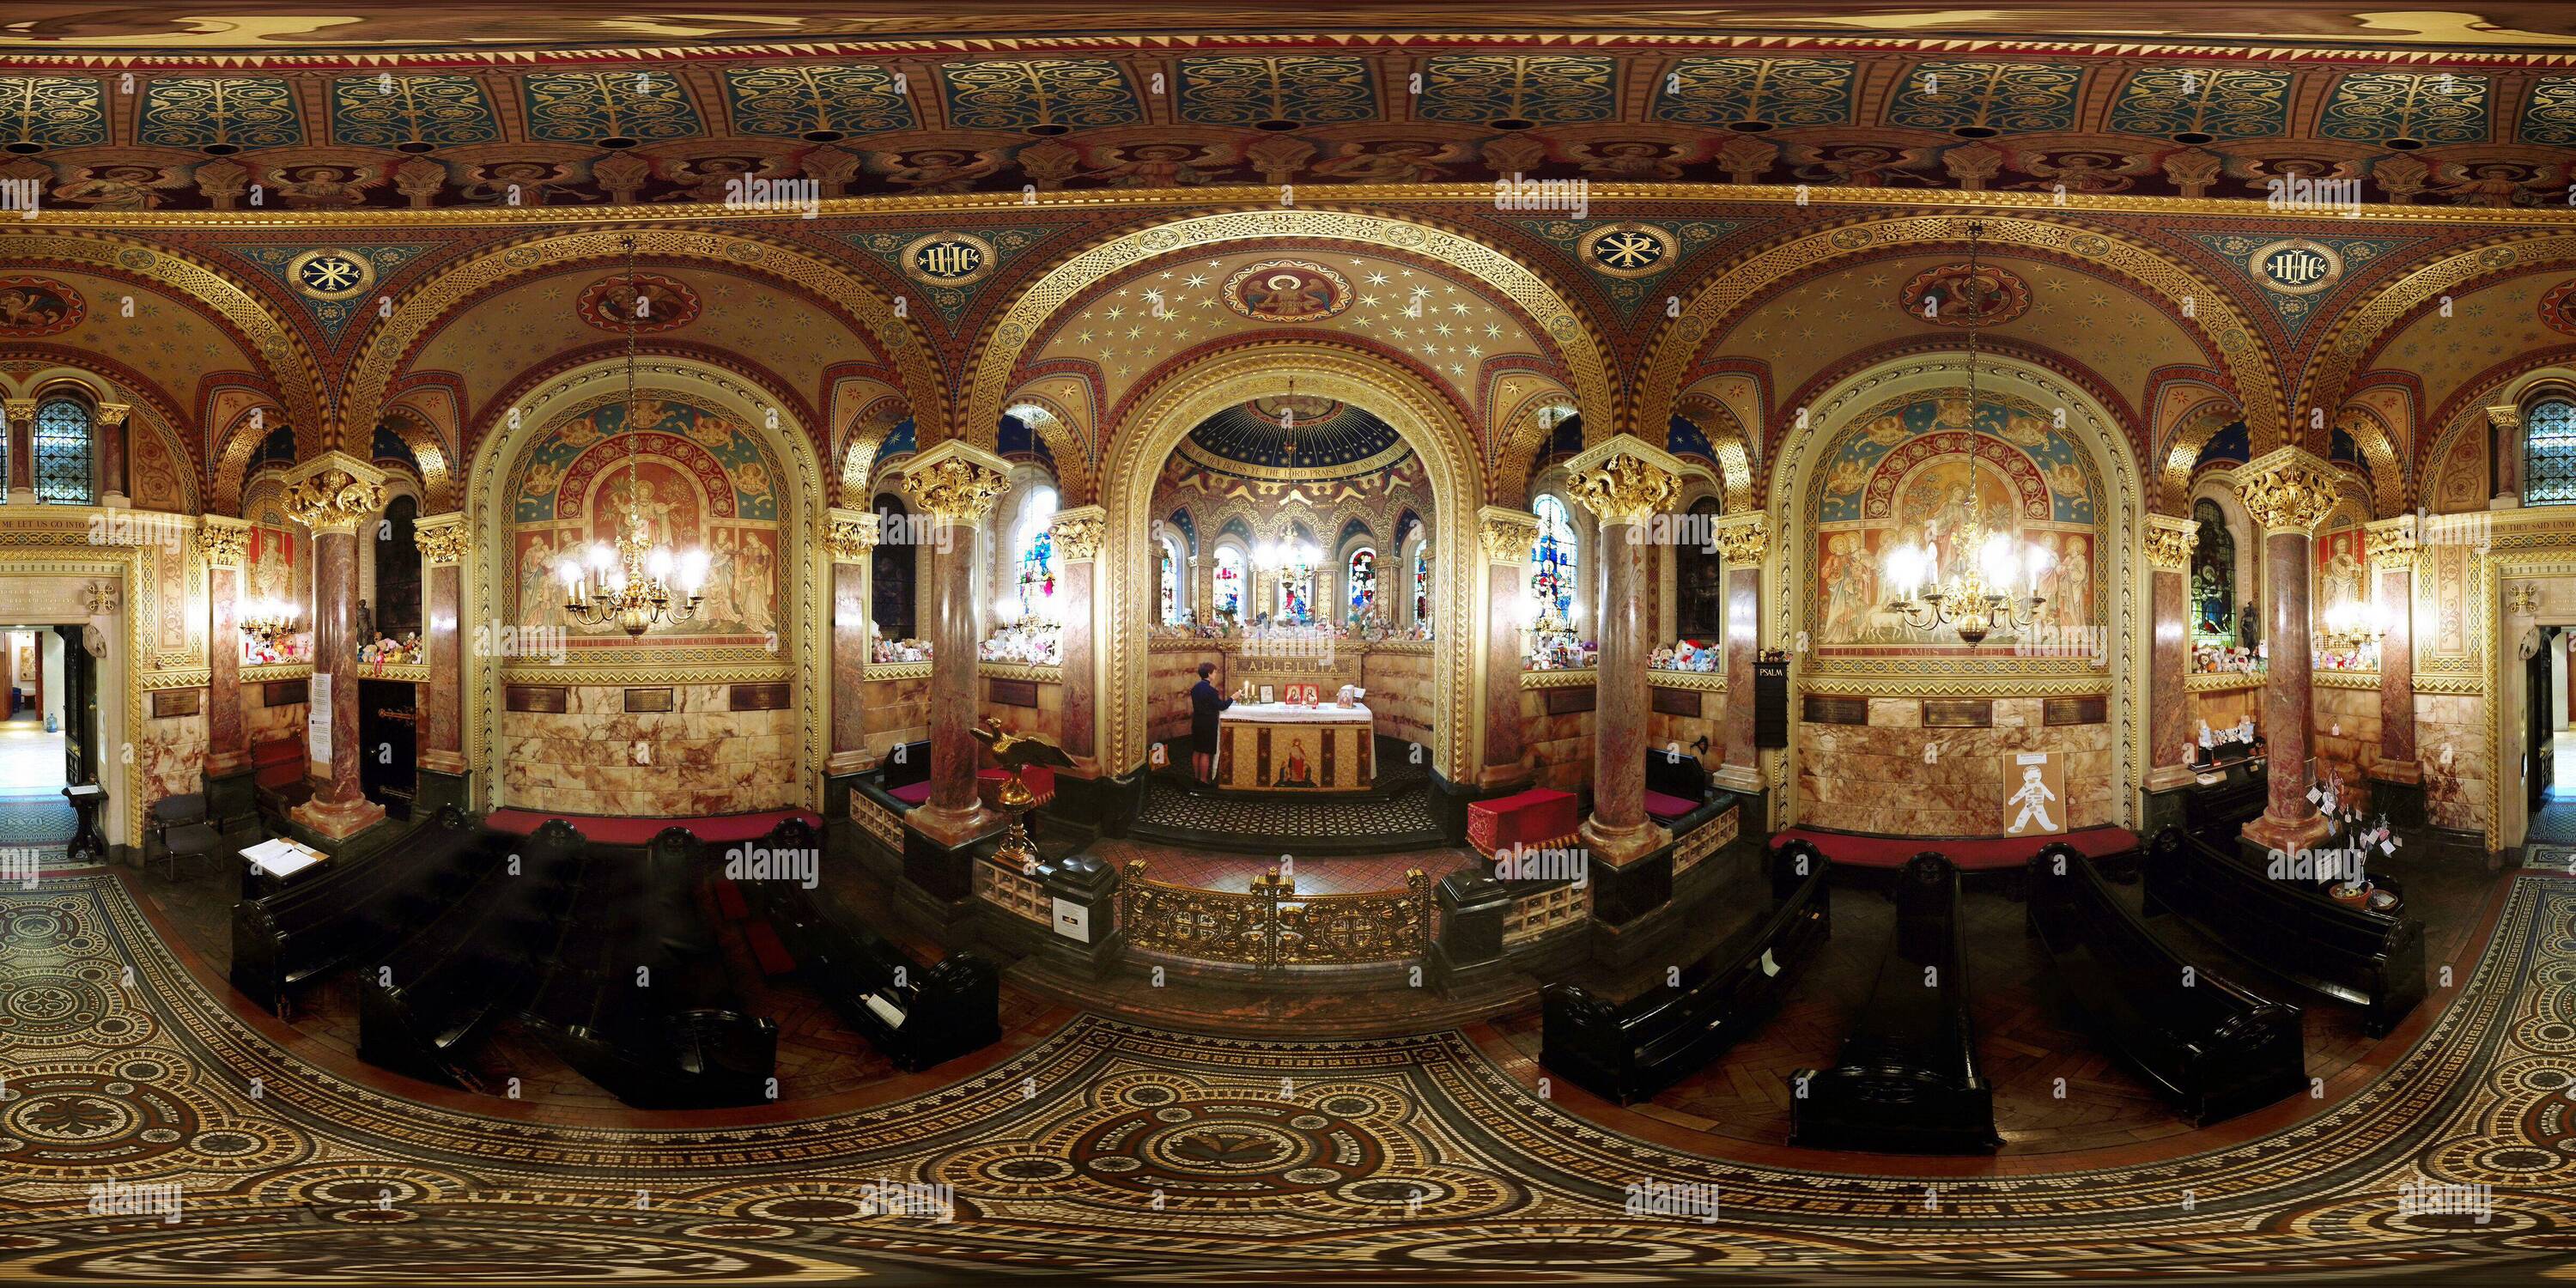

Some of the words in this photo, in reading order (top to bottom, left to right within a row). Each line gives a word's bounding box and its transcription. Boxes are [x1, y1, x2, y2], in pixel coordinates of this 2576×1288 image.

[1224, 461, 1247, 473] BLESS
[1251, 466, 1259, 475] YE
[1265, 468, 1279, 477] THE
[1309, 468, 1337, 477] PRAISE
[1342, 465, 1358, 474] HIM
[1361, 459, 1375, 470] AND
[2509, 523, 2528, 532] THEY
[1900, 647, 1940, 656] LAMBS
[1248, 661, 1339, 672] ALLELUIA
[1759, 668, 1783, 677] PSALM
